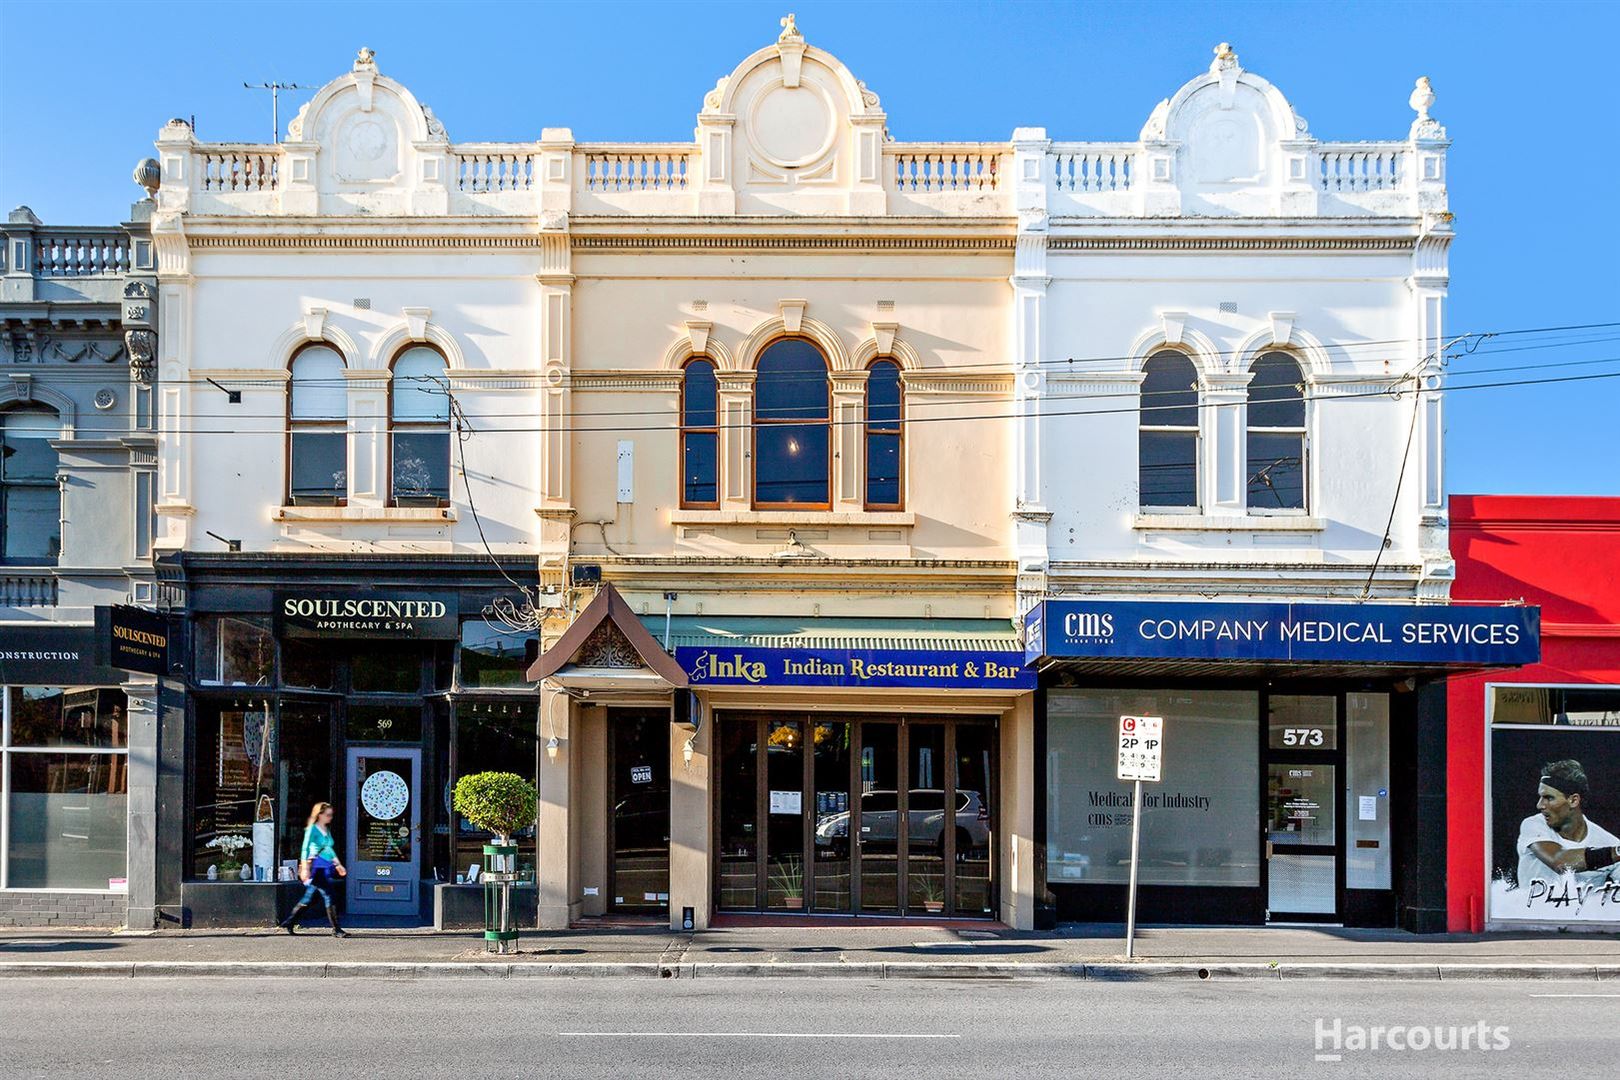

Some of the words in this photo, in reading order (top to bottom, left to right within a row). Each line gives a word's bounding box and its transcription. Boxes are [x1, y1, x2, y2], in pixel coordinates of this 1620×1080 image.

[284, 599, 447, 618] SOULSCENTED
[317, 621, 380, 630] APOTHECARY
[385, 622, 391, 630] &
[395, 622, 413, 630] SPA
[1065, 613, 1114, 637] cms
[1139, 619, 1268, 641] COMPANY
[1280, 621, 1392, 643] MEDICAL
[1402, 623, 1520, 645] SERVICES
[113, 625, 166, 648] SOULSCENTED
[709, 653, 768, 683] Inka
[783, 659, 844, 675] Indian
[850, 659, 958, 679] Restaurant
[963, 662, 979, 678] &
[984, 662, 1020, 679] Bar
[377, 719, 392, 728] 569
[1124, 718, 1135, 731] C
[1122, 738, 1139, 749] 2P
[1144, 739, 1159, 750] 1P
[1283, 729, 1324, 746] 573
[632, 773, 651, 781] OPEN
[1088, 791, 1140, 807] Medical
[1143, 792, 1159, 808] for
[1163, 792, 1211, 811] Industry
[1088, 813, 1113, 826] cms
